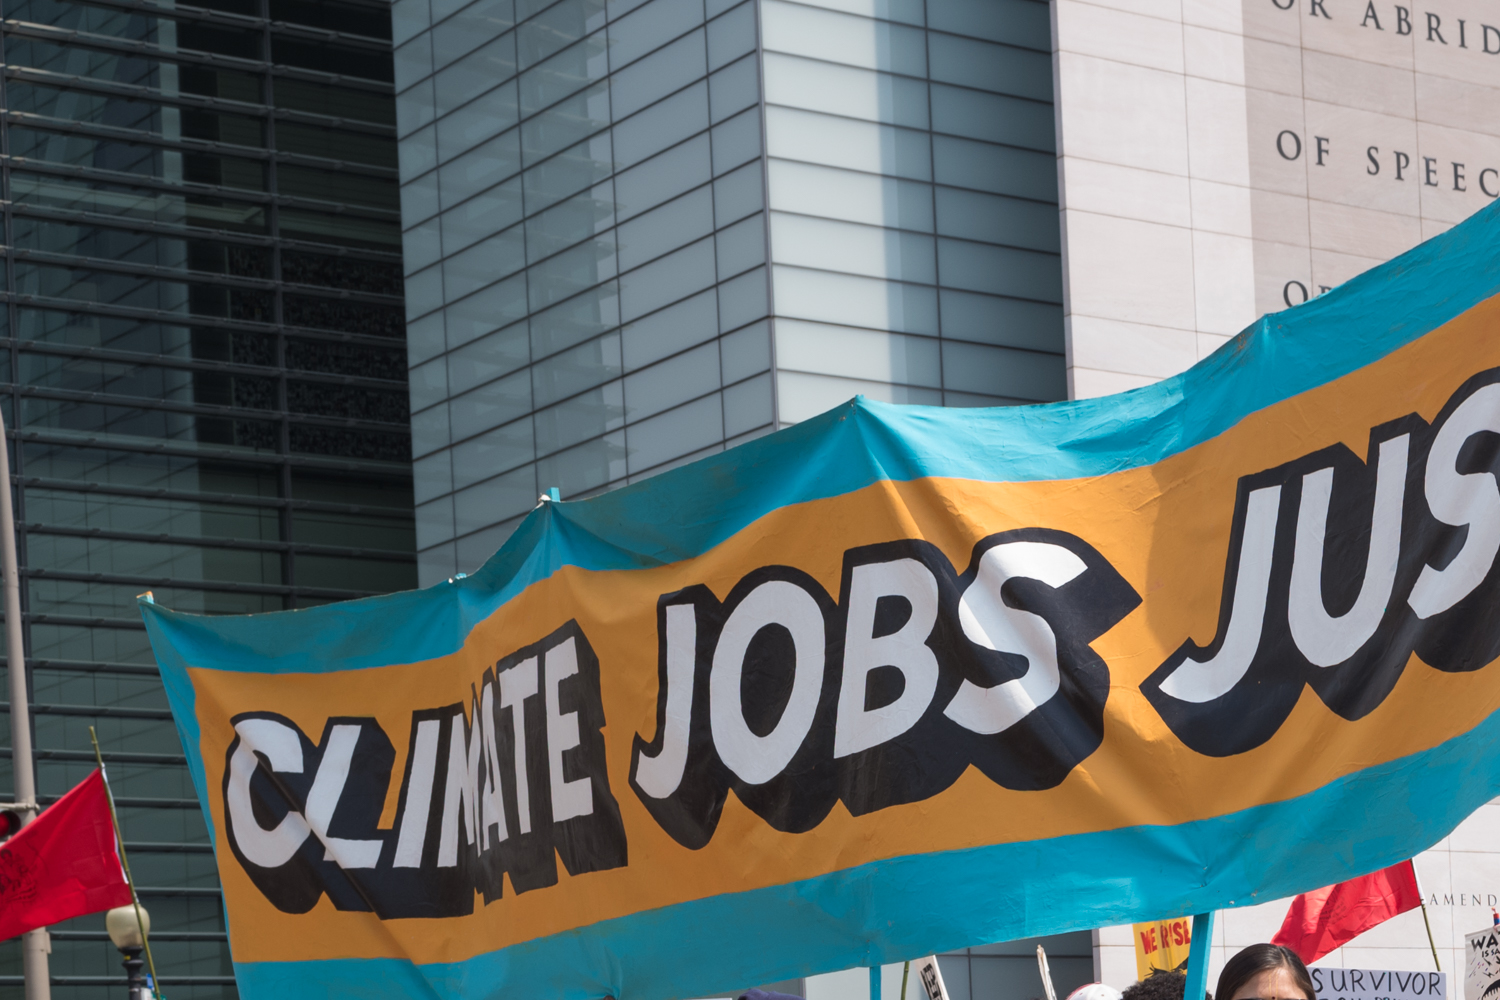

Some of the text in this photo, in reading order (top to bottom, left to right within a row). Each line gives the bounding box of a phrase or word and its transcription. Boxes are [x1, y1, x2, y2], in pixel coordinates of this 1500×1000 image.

[1275, 129, 1331, 167] OF
[225, 636, 595, 869] CLIMATE
[634, 540, 1090, 800] JOBS
[1140, 926, 1158, 955] WE
[1482, 951, 1490, 959] IS
[1311, 967, 1442, 997] SURVIVOR
